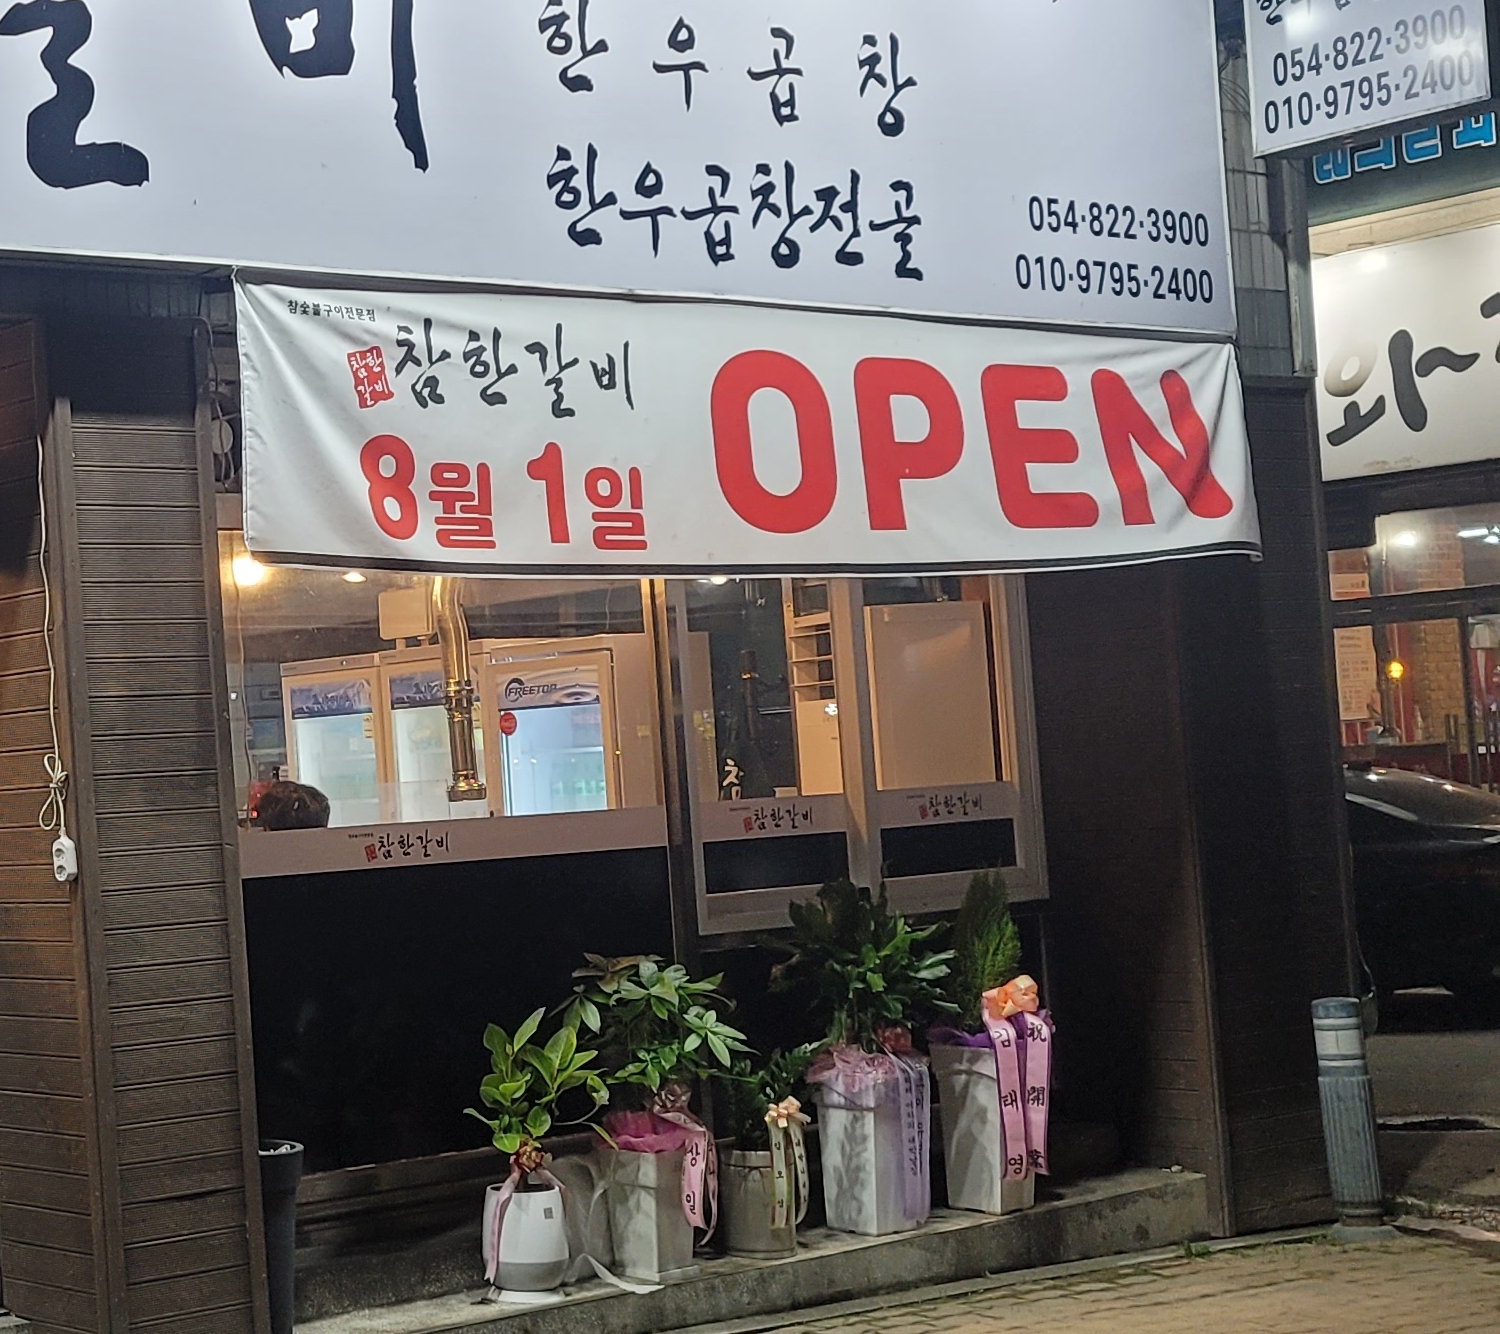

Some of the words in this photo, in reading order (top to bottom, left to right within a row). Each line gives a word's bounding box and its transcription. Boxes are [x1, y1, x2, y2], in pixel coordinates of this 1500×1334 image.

[546, 142, 924, 281] 한우곱창전골
[1028, 195, 1209, 247] 054·822·3900
[1015, 253, 1213, 304] 010·9795·2400
[394, 318, 634, 418] 참한갈비
[709, 348, 1233, 535] OPEN
[359, 434, 496, 549] 8월
[526, 441, 648, 551] 1일
[378, 829, 449, 860] 참한갈비
